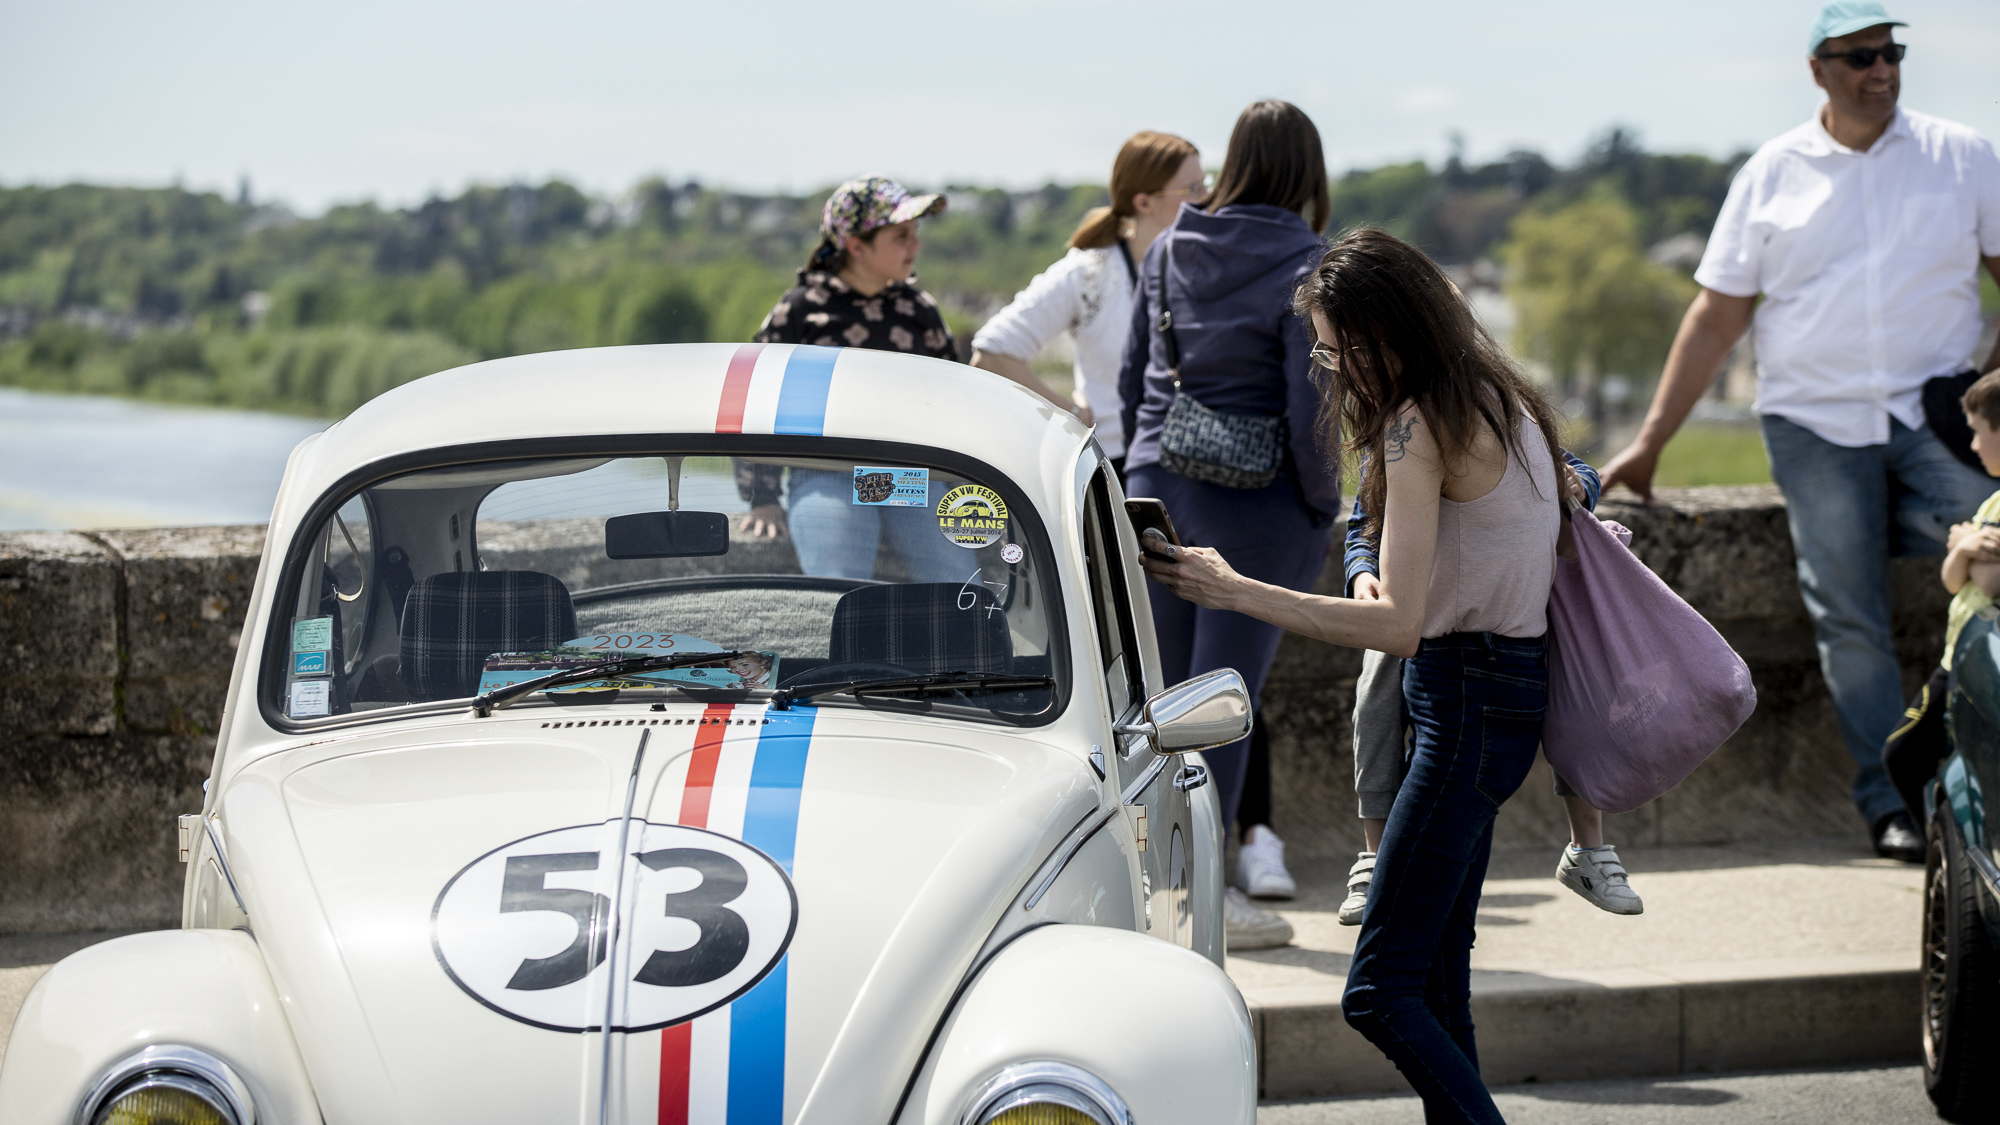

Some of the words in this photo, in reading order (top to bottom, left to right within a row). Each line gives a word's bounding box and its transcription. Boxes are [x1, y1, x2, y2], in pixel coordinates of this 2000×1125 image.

[938, 491, 960, 514] SUPER
[959, 486, 974, 496] VW
[977, 487, 1006, 516] FESTIVAL
[940, 518, 955, 528] LE
[960, 518, 1005, 530] MANS
[592, 634, 674, 649] 2023
[297, 664, 322, 672] MAAF
[500, 847, 750, 991] 53
